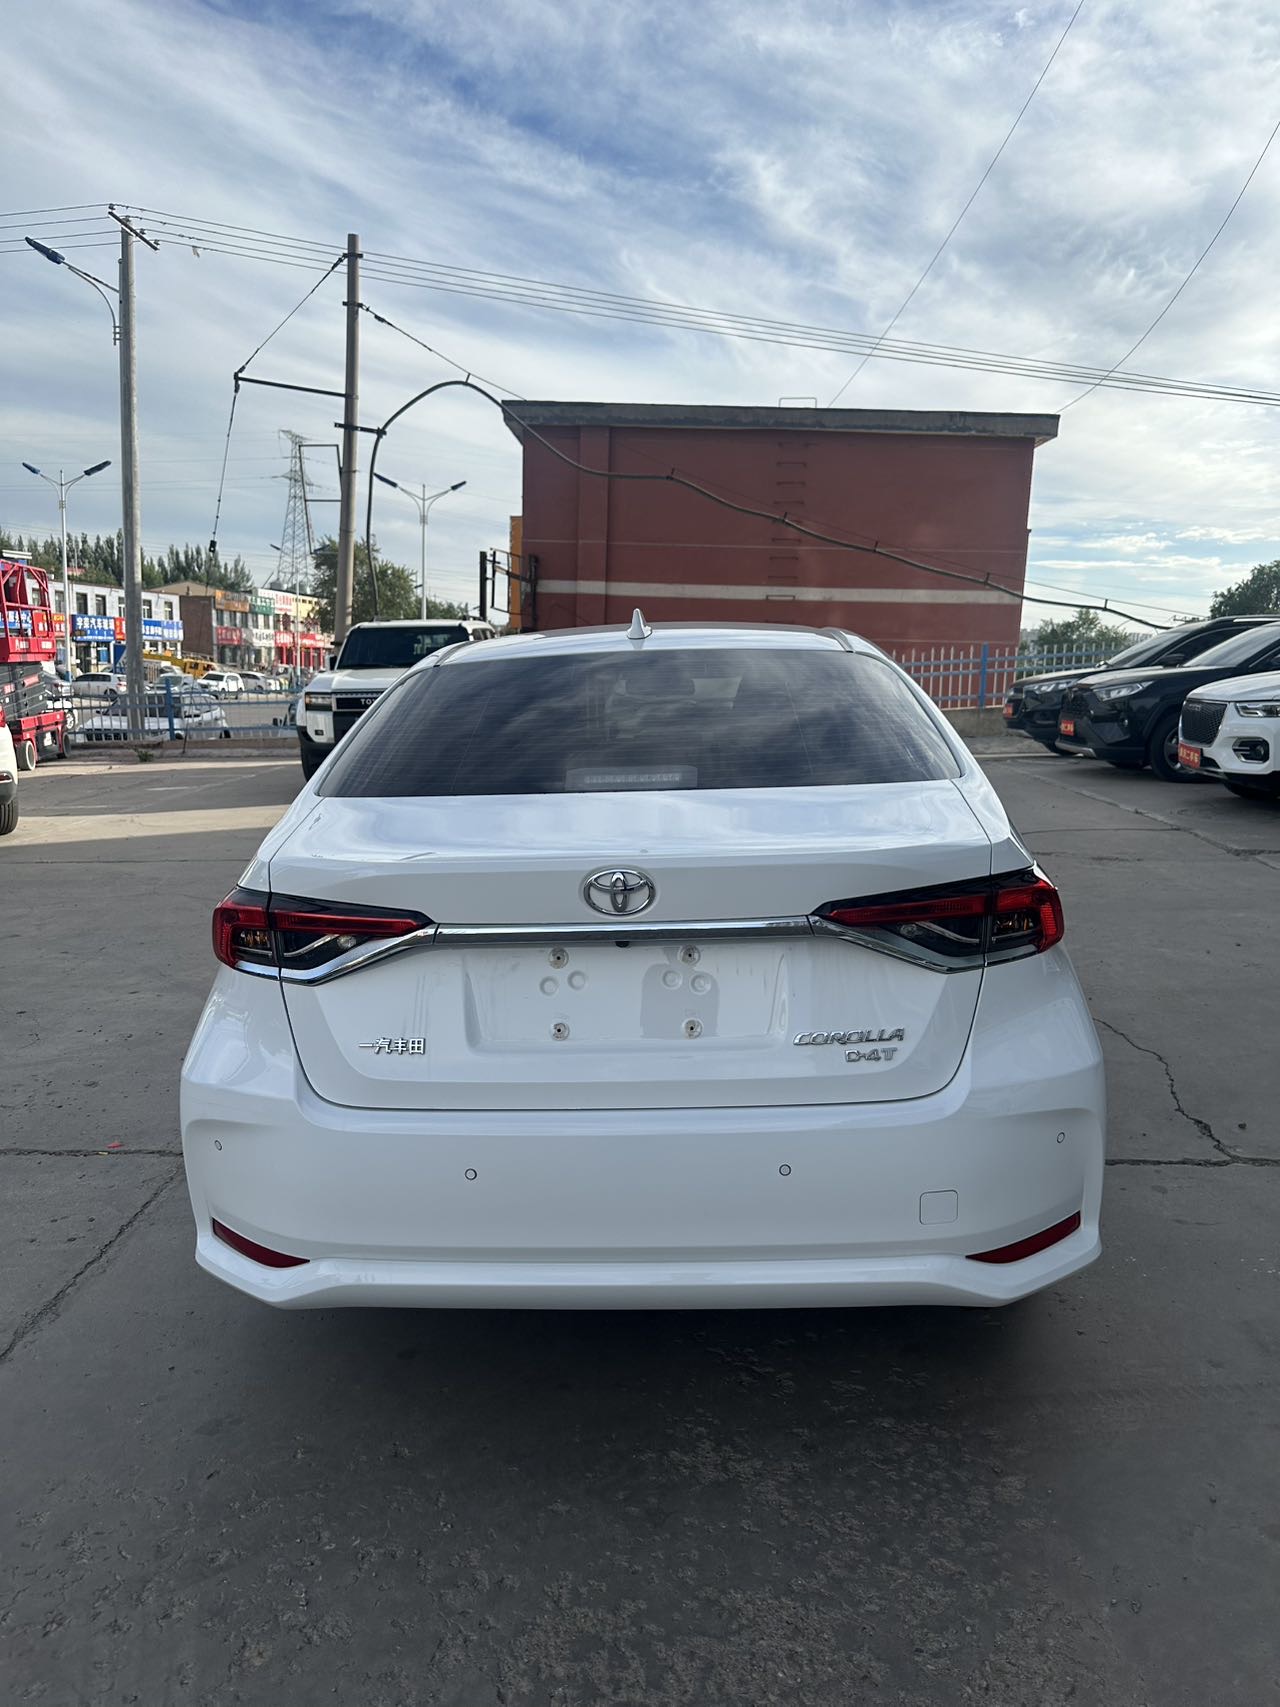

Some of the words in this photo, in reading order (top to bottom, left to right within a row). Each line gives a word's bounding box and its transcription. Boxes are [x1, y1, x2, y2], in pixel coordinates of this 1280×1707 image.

[358, 1037, 426, 1055] 一汽丰田
[793, 1028, 905, 1046] COROLLA
[844, 1047, 898, 1063] D-4T
